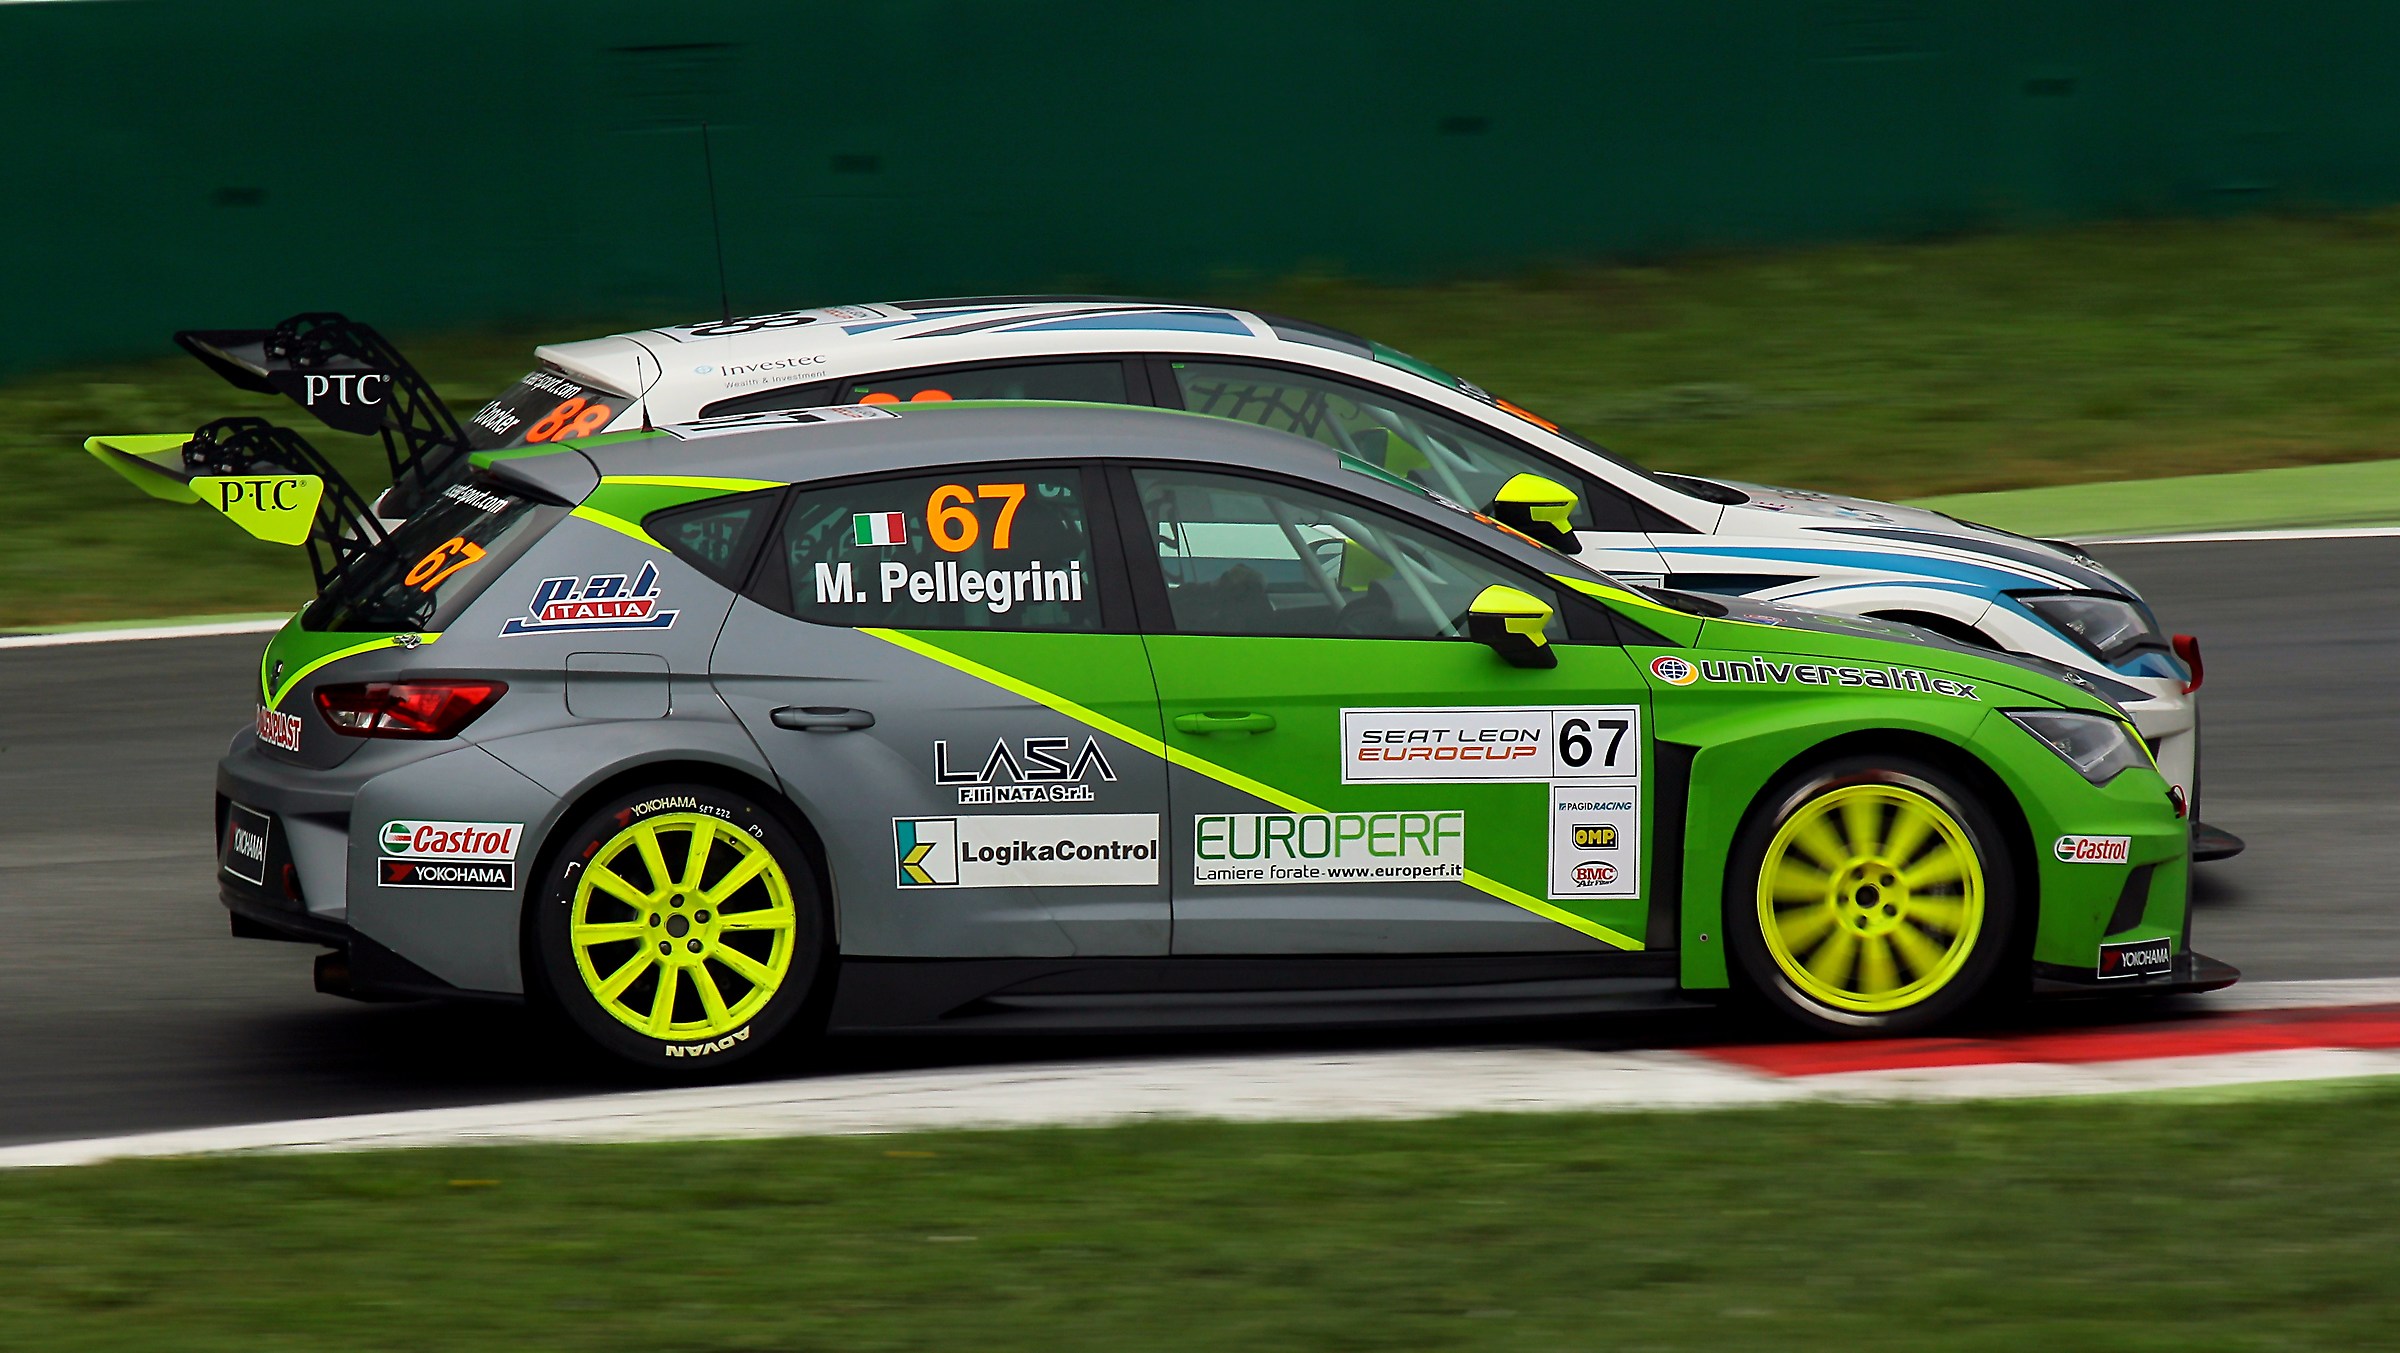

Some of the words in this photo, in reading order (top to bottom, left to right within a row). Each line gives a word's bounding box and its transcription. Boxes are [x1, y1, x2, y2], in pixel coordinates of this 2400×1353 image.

[721, 353, 827, 377] Investec
[725, 378, 759, 389] Wealth
[763, 376, 770, 384] &
[772, 370, 827, 384] Investment
[525, 397, 611, 443] 88
[926, 483, 1027, 552] 67
[404, 536, 487, 592] 67
[814, 562, 867, 603] M.
[880, 560, 1082, 613] Pellegrini
[549, 602, 644, 619] ITALIA
[1701, 656, 1981, 701] universalflex
[1361, 729, 1450, 744] SEAT
[1458, 728, 1541, 743] LEON
[1558, 718, 1629, 767] 67
[935, 735, 1117, 785] LASA
[1358, 746, 1538, 761] EUROCUP
[995, 786, 1049, 802] NATA
[1050, 784, 1094, 802] S.r.l.
[631, 796, 697, 817] YOKOHAMA
[233, 828, 263, 861] YOKOHAMA
[413, 825, 512, 854] Castrol
[1196, 813, 1462, 860] EUROPERF
[962, 840, 1158, 865] LogikaControl
[2076, 839, 2127, 860] Castrol
[415, 866, 506, 883] YOKOHAMA
[1196, 866, 1264, 881] Lamiere
[1576, 868, 1614, 880] BMC
[2121, 948, 2169, 967] YOKOHAMA
[665, 1025, 750, 1057] ADVAN
